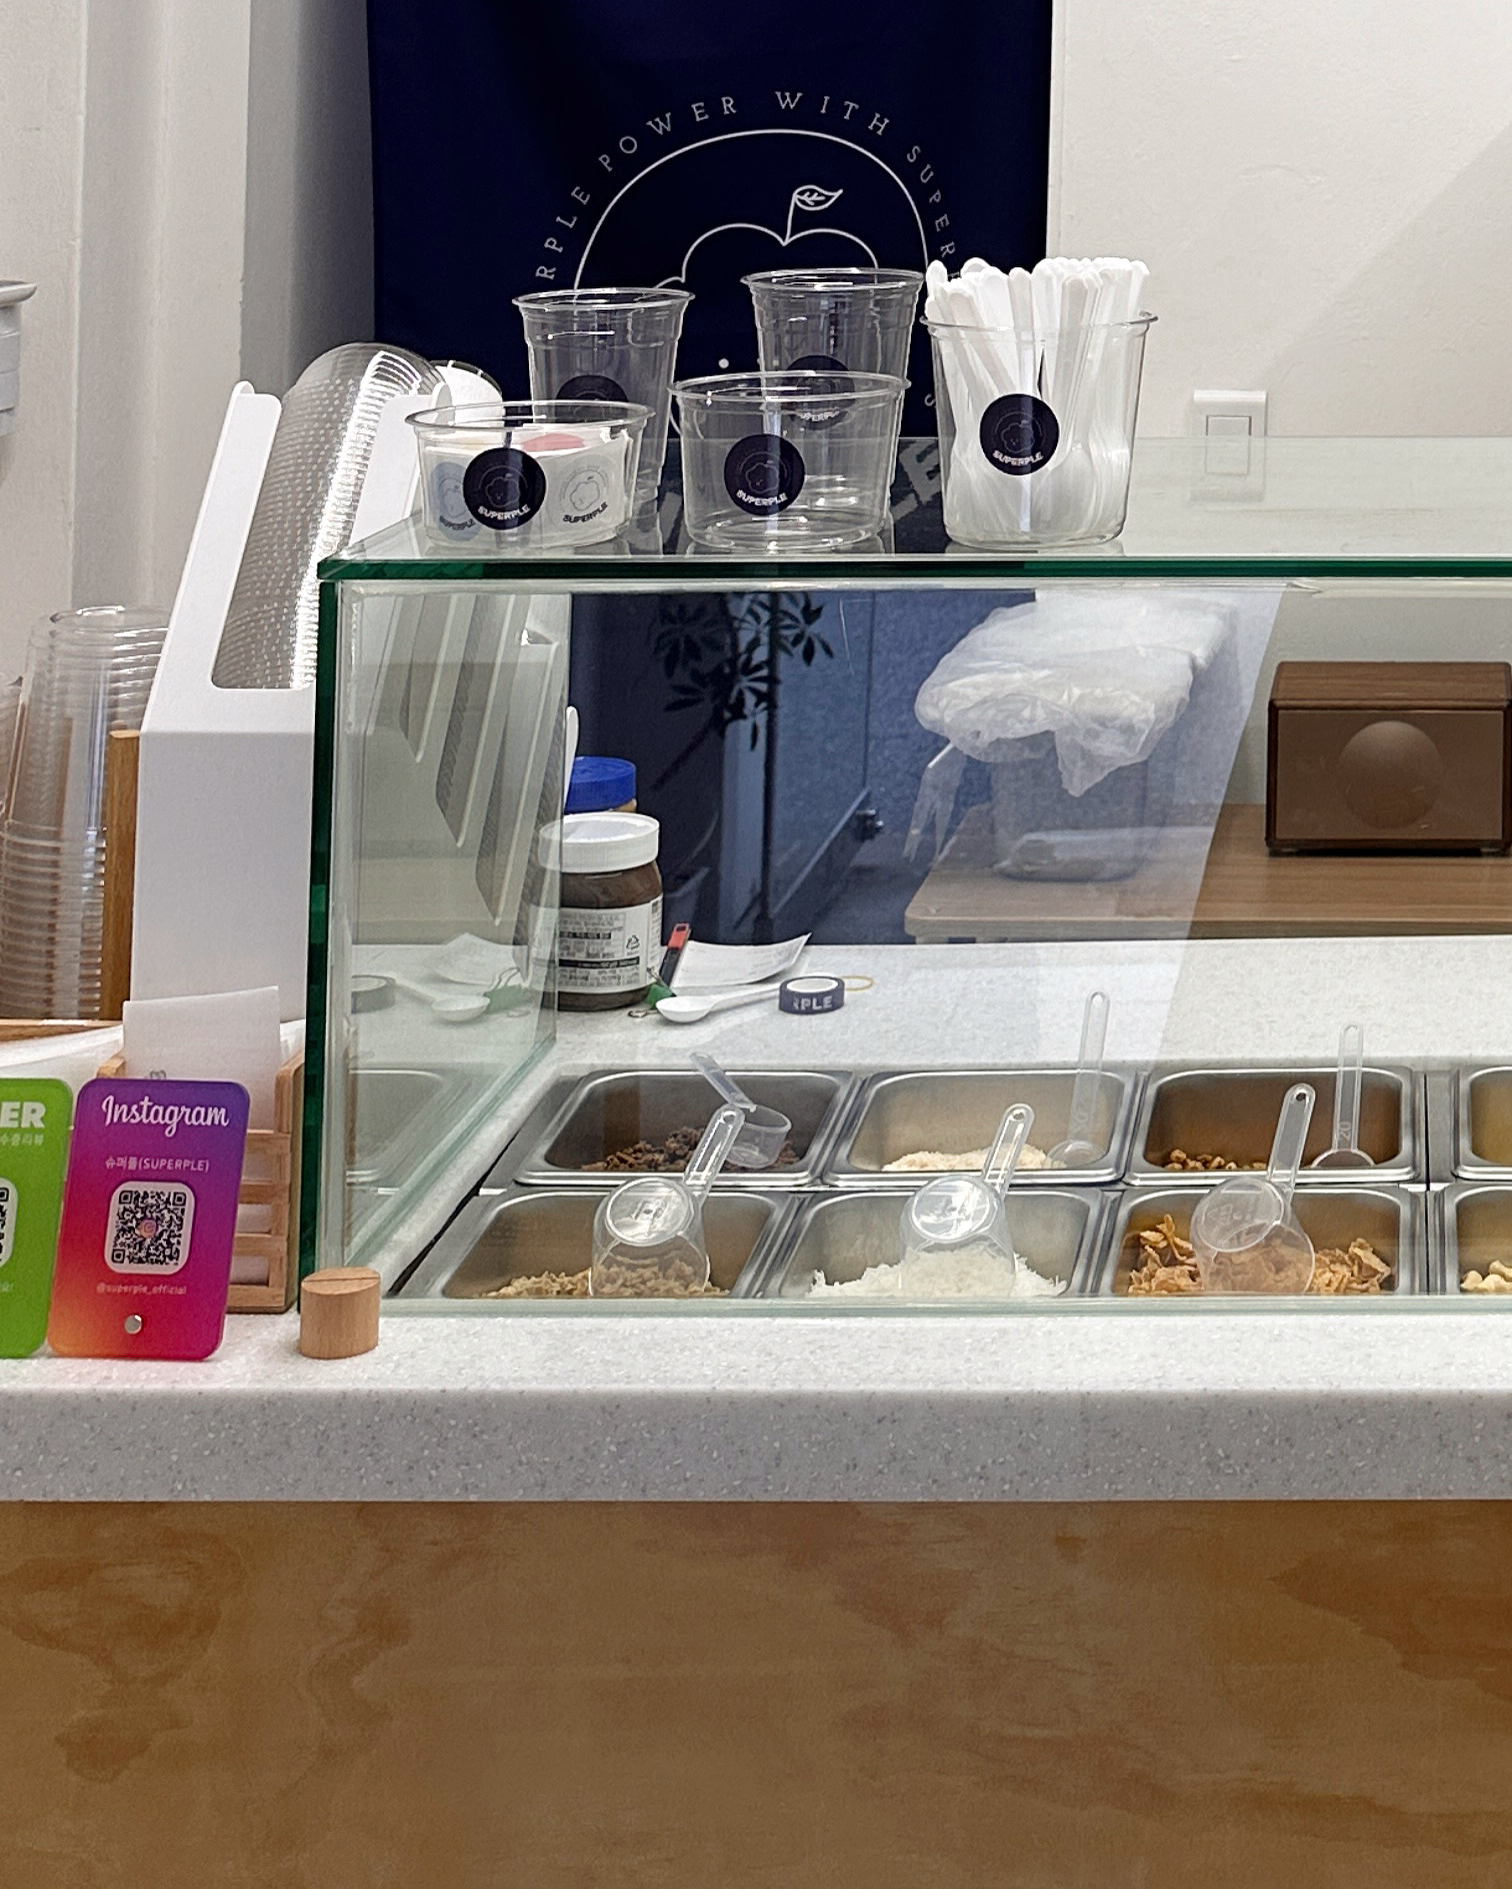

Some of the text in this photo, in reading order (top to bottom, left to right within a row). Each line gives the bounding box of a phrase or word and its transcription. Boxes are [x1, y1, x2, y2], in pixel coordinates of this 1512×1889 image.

[598, 95, 738, 173] POWER
[774, 90, 891, 136] WITH
[905, 144, 960, 279] SUPER
[477, 504, 531, 522] SUPERPLE
[101, 1094, 231, 1138] Instagram
